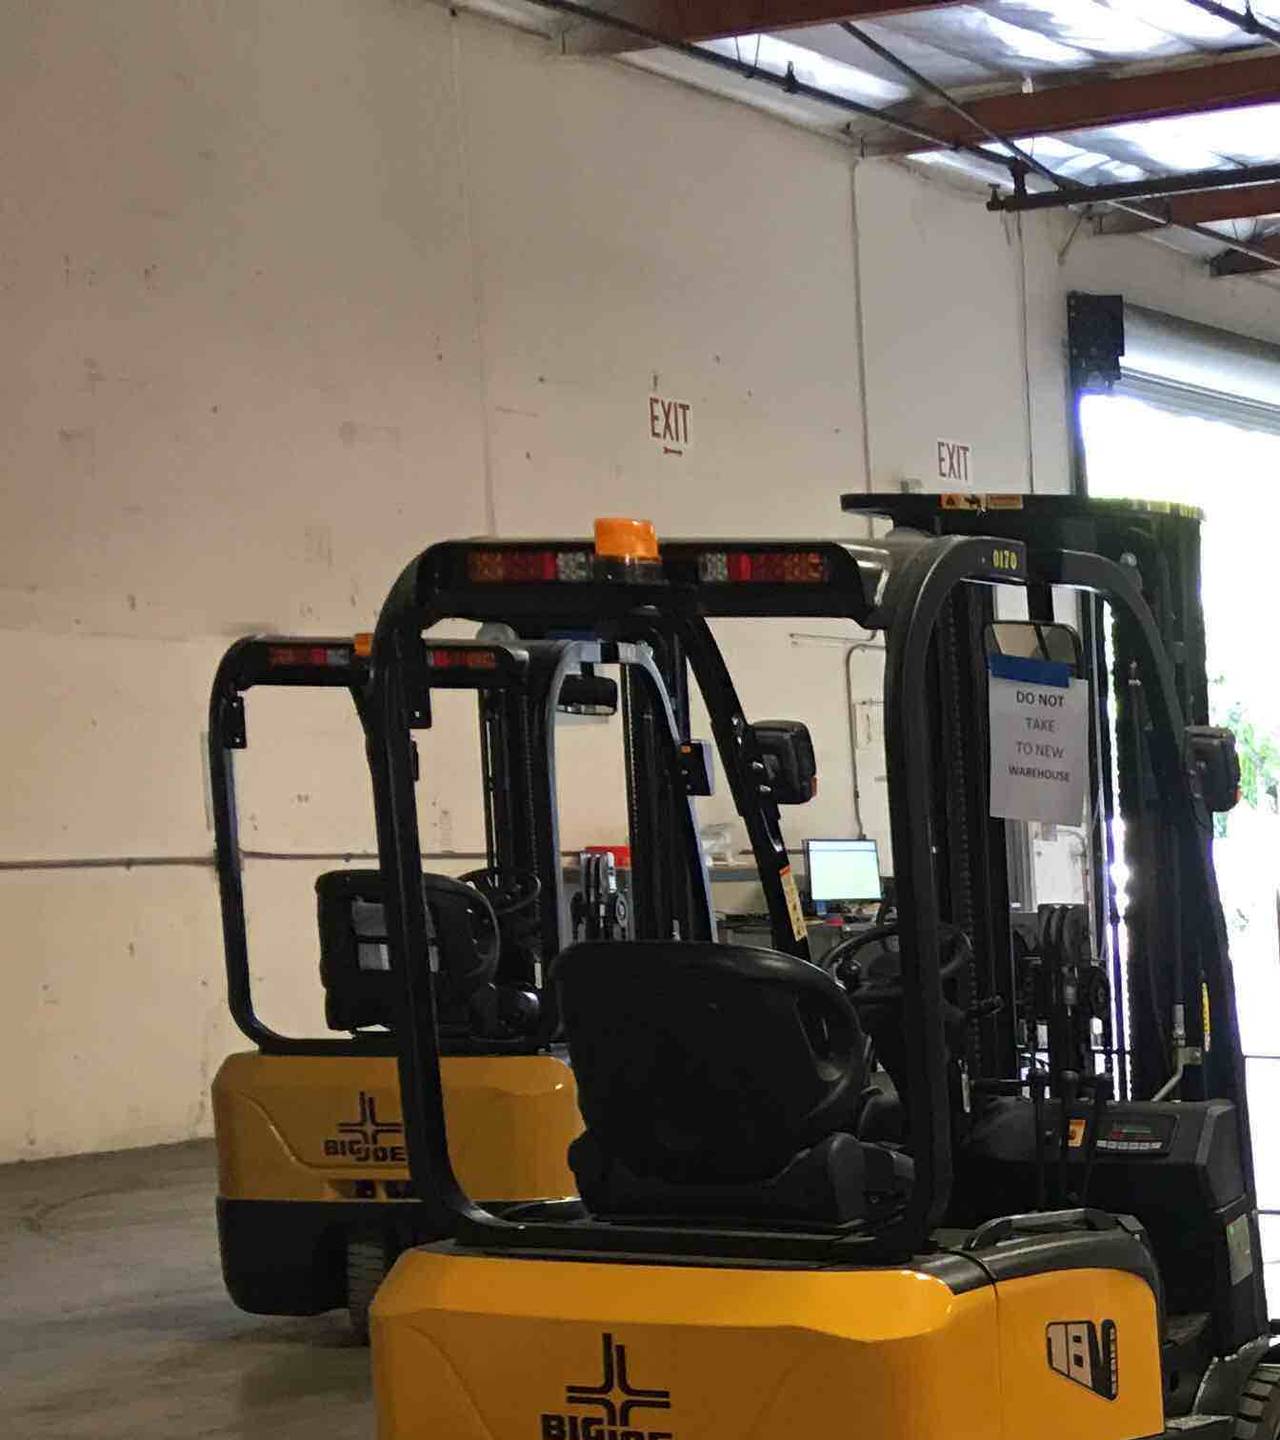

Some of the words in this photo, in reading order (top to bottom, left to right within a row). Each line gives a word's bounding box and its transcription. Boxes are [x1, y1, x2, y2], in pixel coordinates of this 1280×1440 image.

[649, 397, 690, 444] EXIT
[937, 441, 970, 481] EXIT
[1016, 690, 1035, 705] DO
[1038, 692, 1065, 708] NOT
[1025, 717, 1056, 733] TAKE
[1015, 741, 1033, 756] TO
[1035, 743, 1065, 759] NEW
[1007, 765, 1071, 783] WAREHOUSE
[324, 1139, 363, 1156] BIG
[356, 1146, 406, 1162] JOE
